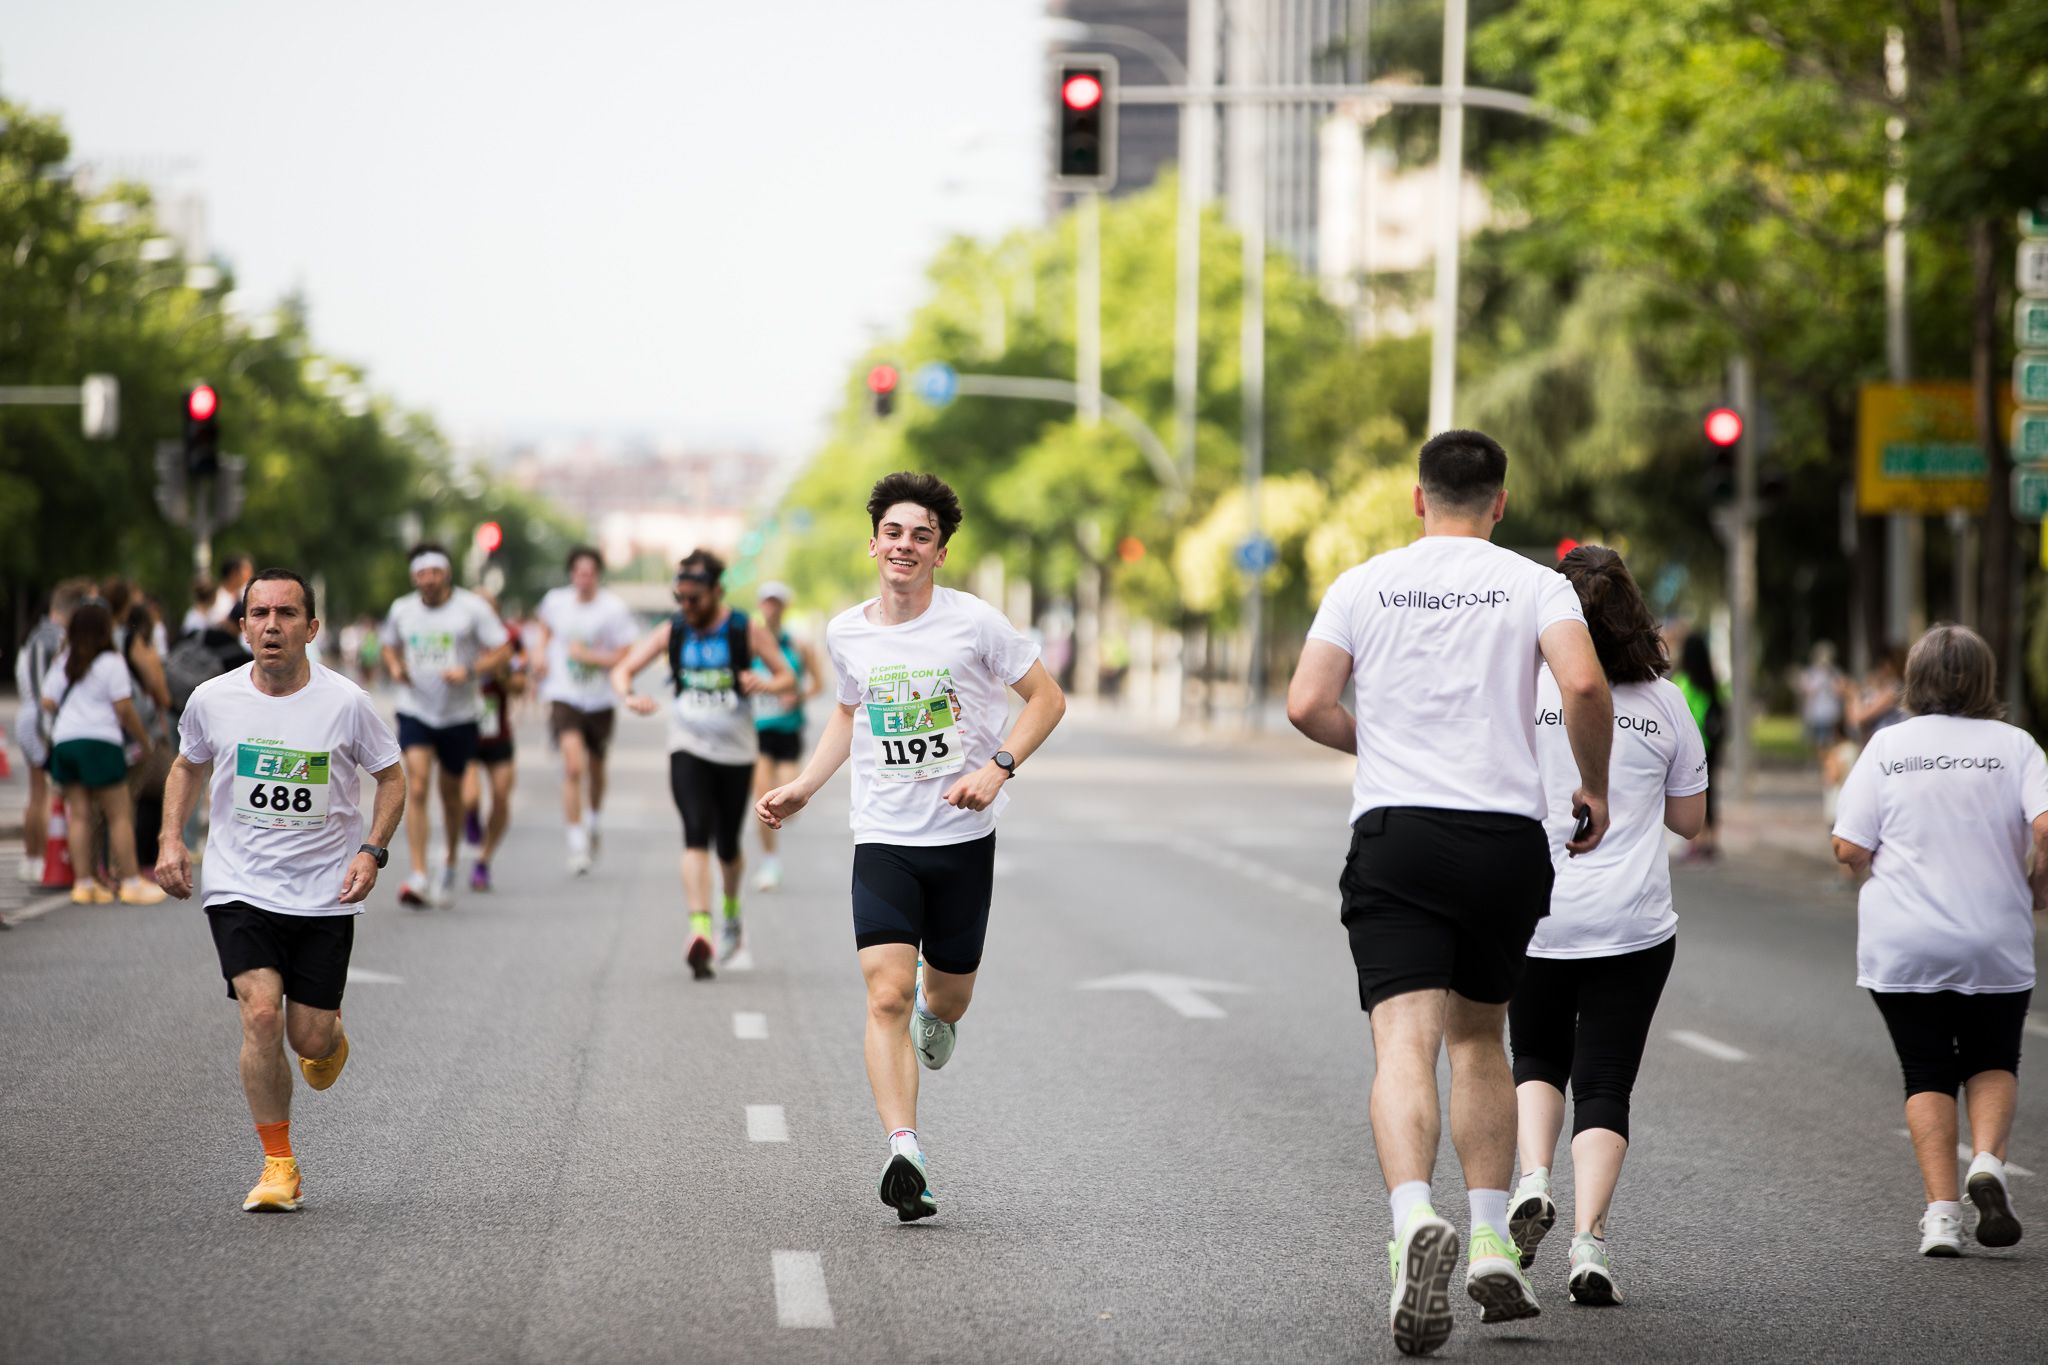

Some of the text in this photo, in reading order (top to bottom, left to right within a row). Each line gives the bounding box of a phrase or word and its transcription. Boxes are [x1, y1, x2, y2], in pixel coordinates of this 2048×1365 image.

[1378, 590, 1510, 610] VelillaGroup.
[869, 667, 951, 684] MADRID CON LA
[883, 708, 935, 733] ELA
[881, 732, 949, 765] 1193
[254, 753, 309, 780] ELA
[1879, 755, 2005, 776] VelillaGroup.
[249, 783, 312, 813] 688
